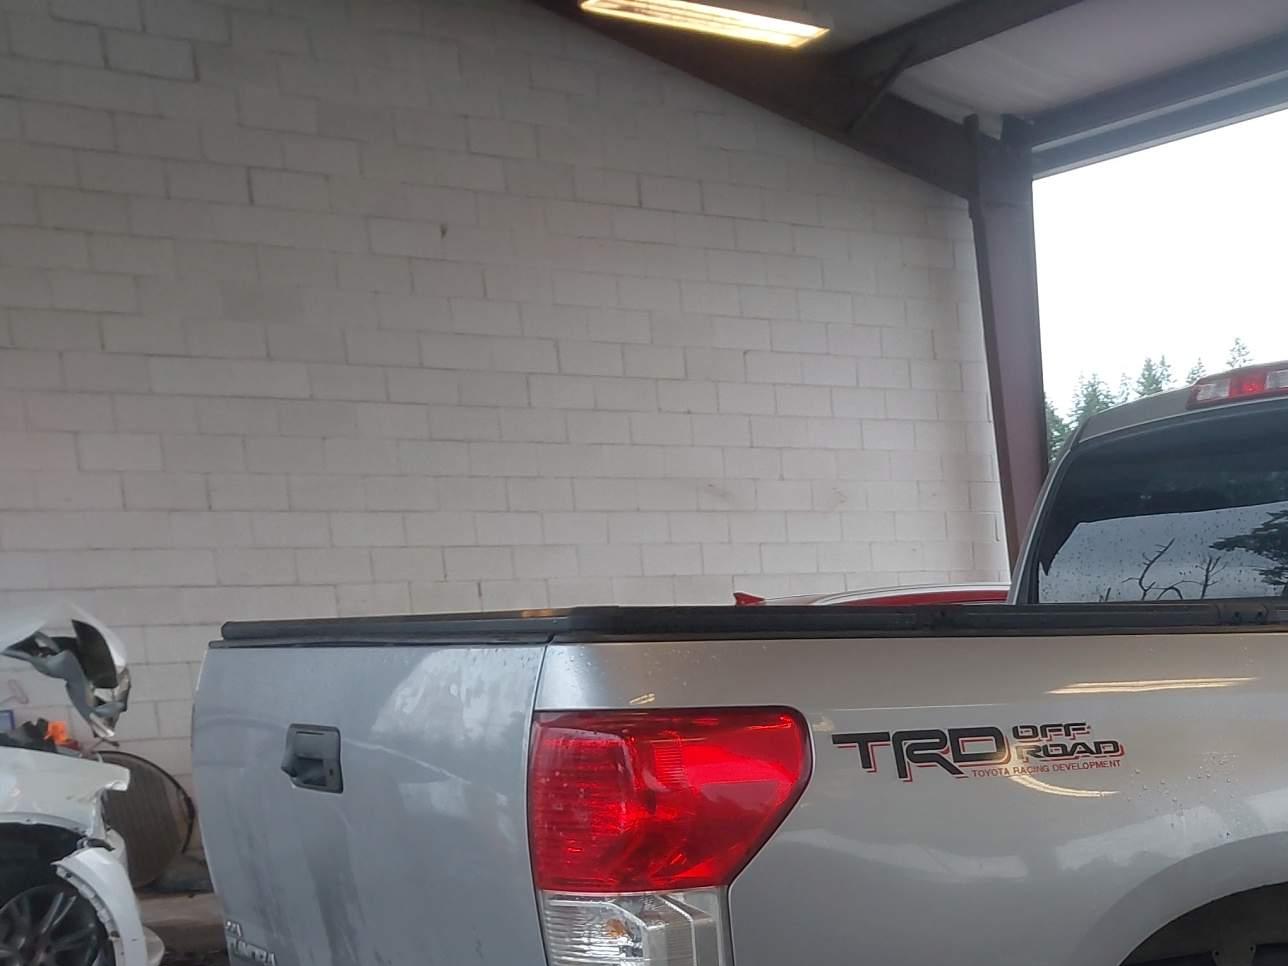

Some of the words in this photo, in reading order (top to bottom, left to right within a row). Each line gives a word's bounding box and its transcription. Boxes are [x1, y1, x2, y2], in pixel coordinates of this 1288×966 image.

[1012, 722, 1091, 742] OFF
[832, 726, 1011, 782] TRD
[1014, 740, 1125, 763] ROAD
[972, 766, 1009, 778] TOYOTA
[1012, 763, 1050, 775] RACING
[1052, 759, 1122, 772] DEVELOPMENT
